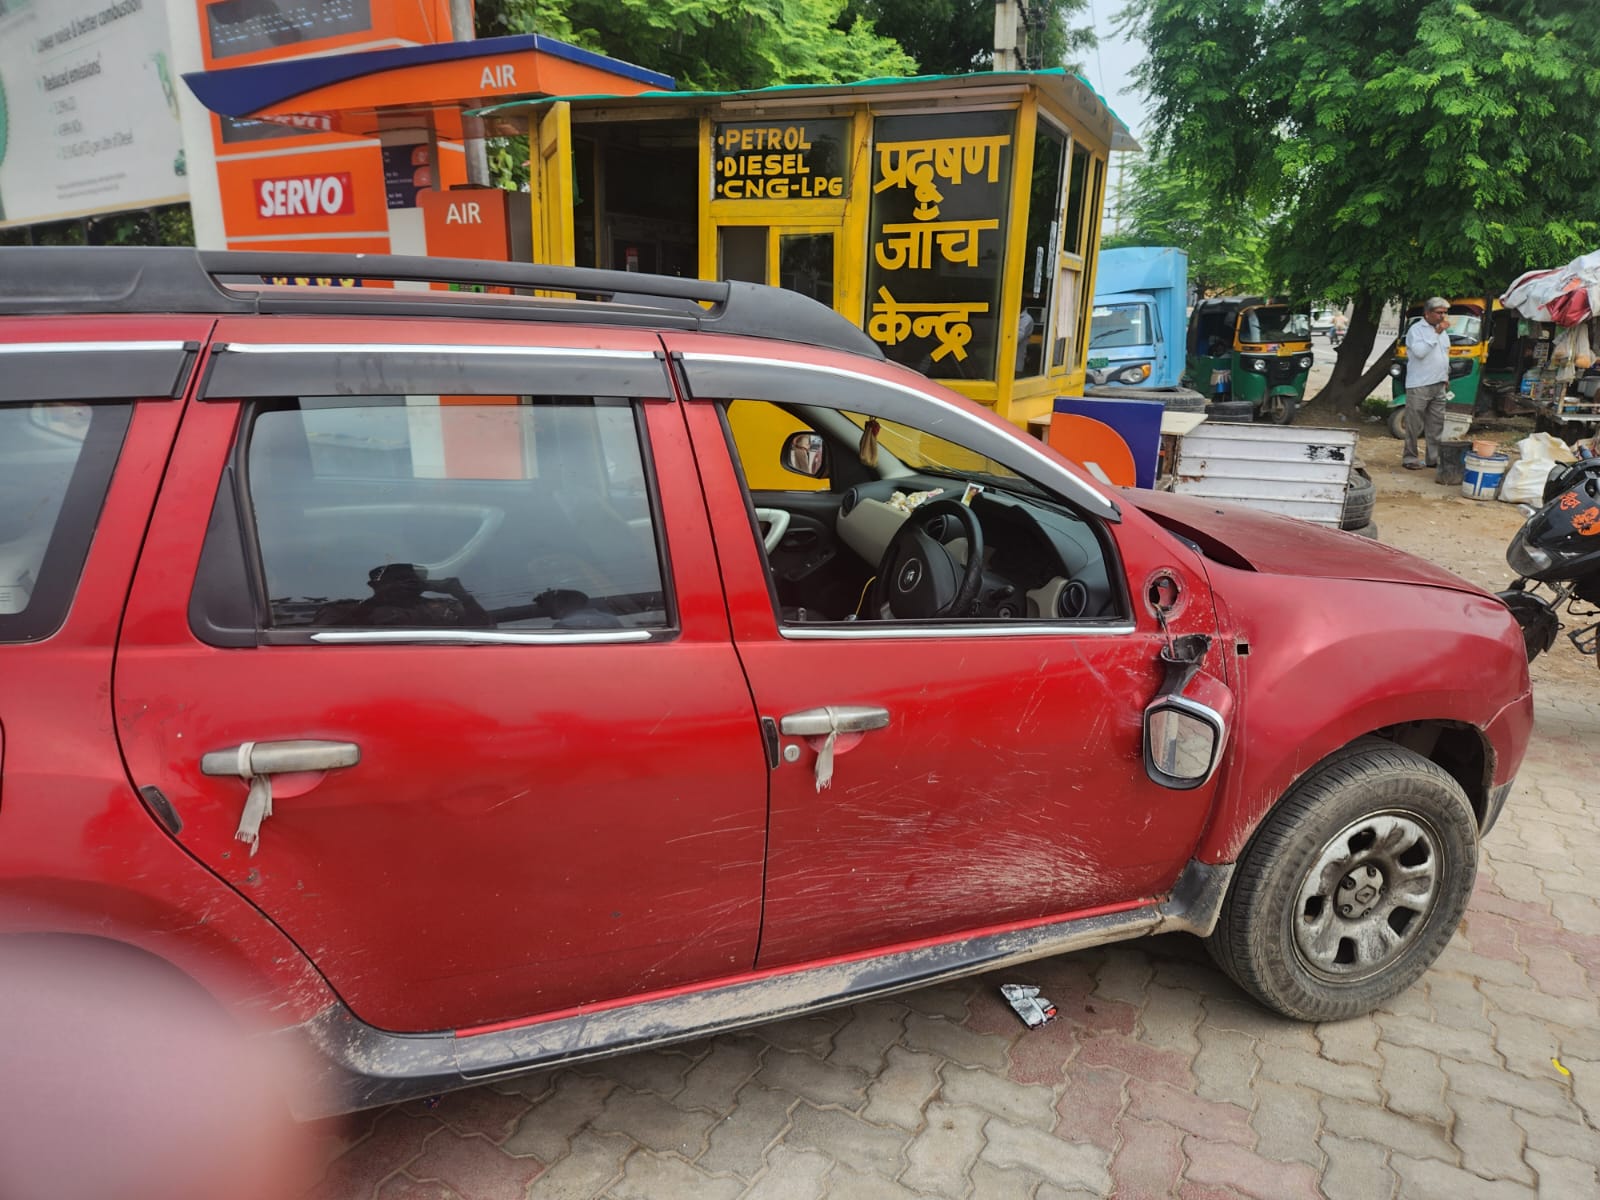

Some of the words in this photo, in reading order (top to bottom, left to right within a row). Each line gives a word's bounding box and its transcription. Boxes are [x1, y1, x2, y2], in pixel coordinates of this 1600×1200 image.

[479, 64, 517, 89] AIR
[724, 127, 812, 151] PETROL
[724, 154, 810, 177] DIESEL
[873, 134, 1011, 202] प्रदूषण
[259, 176, 344, 218] SERVO
[723, 176, 843, 199] CNG-LPG
[446, 203, 482, 225] AIR
[868, 285, 989, 363] केन्द्र
